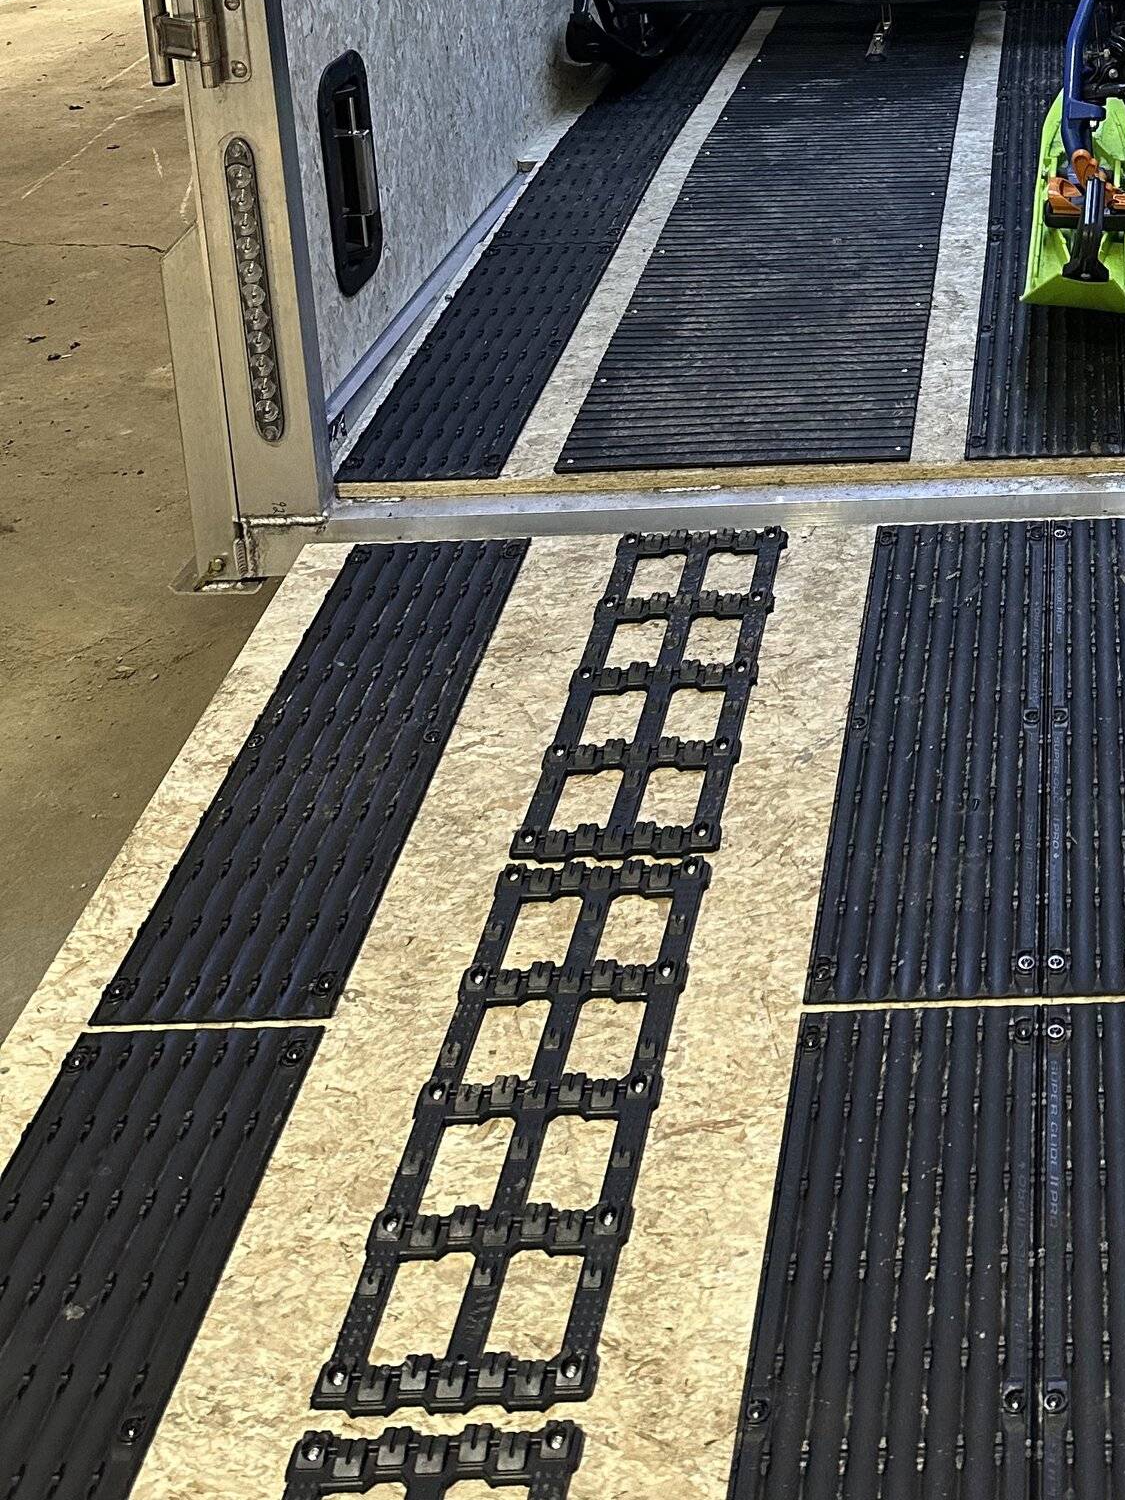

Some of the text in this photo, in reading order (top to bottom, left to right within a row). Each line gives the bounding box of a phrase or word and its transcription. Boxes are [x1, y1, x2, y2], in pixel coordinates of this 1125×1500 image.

[1052, 736, 1061, 773] SUPER
[1052, 823, 1060, 849] PRO
[1050, 1060, 1059, 1115] SUPER
[1049, 1190, 1059, 1228] PRO
